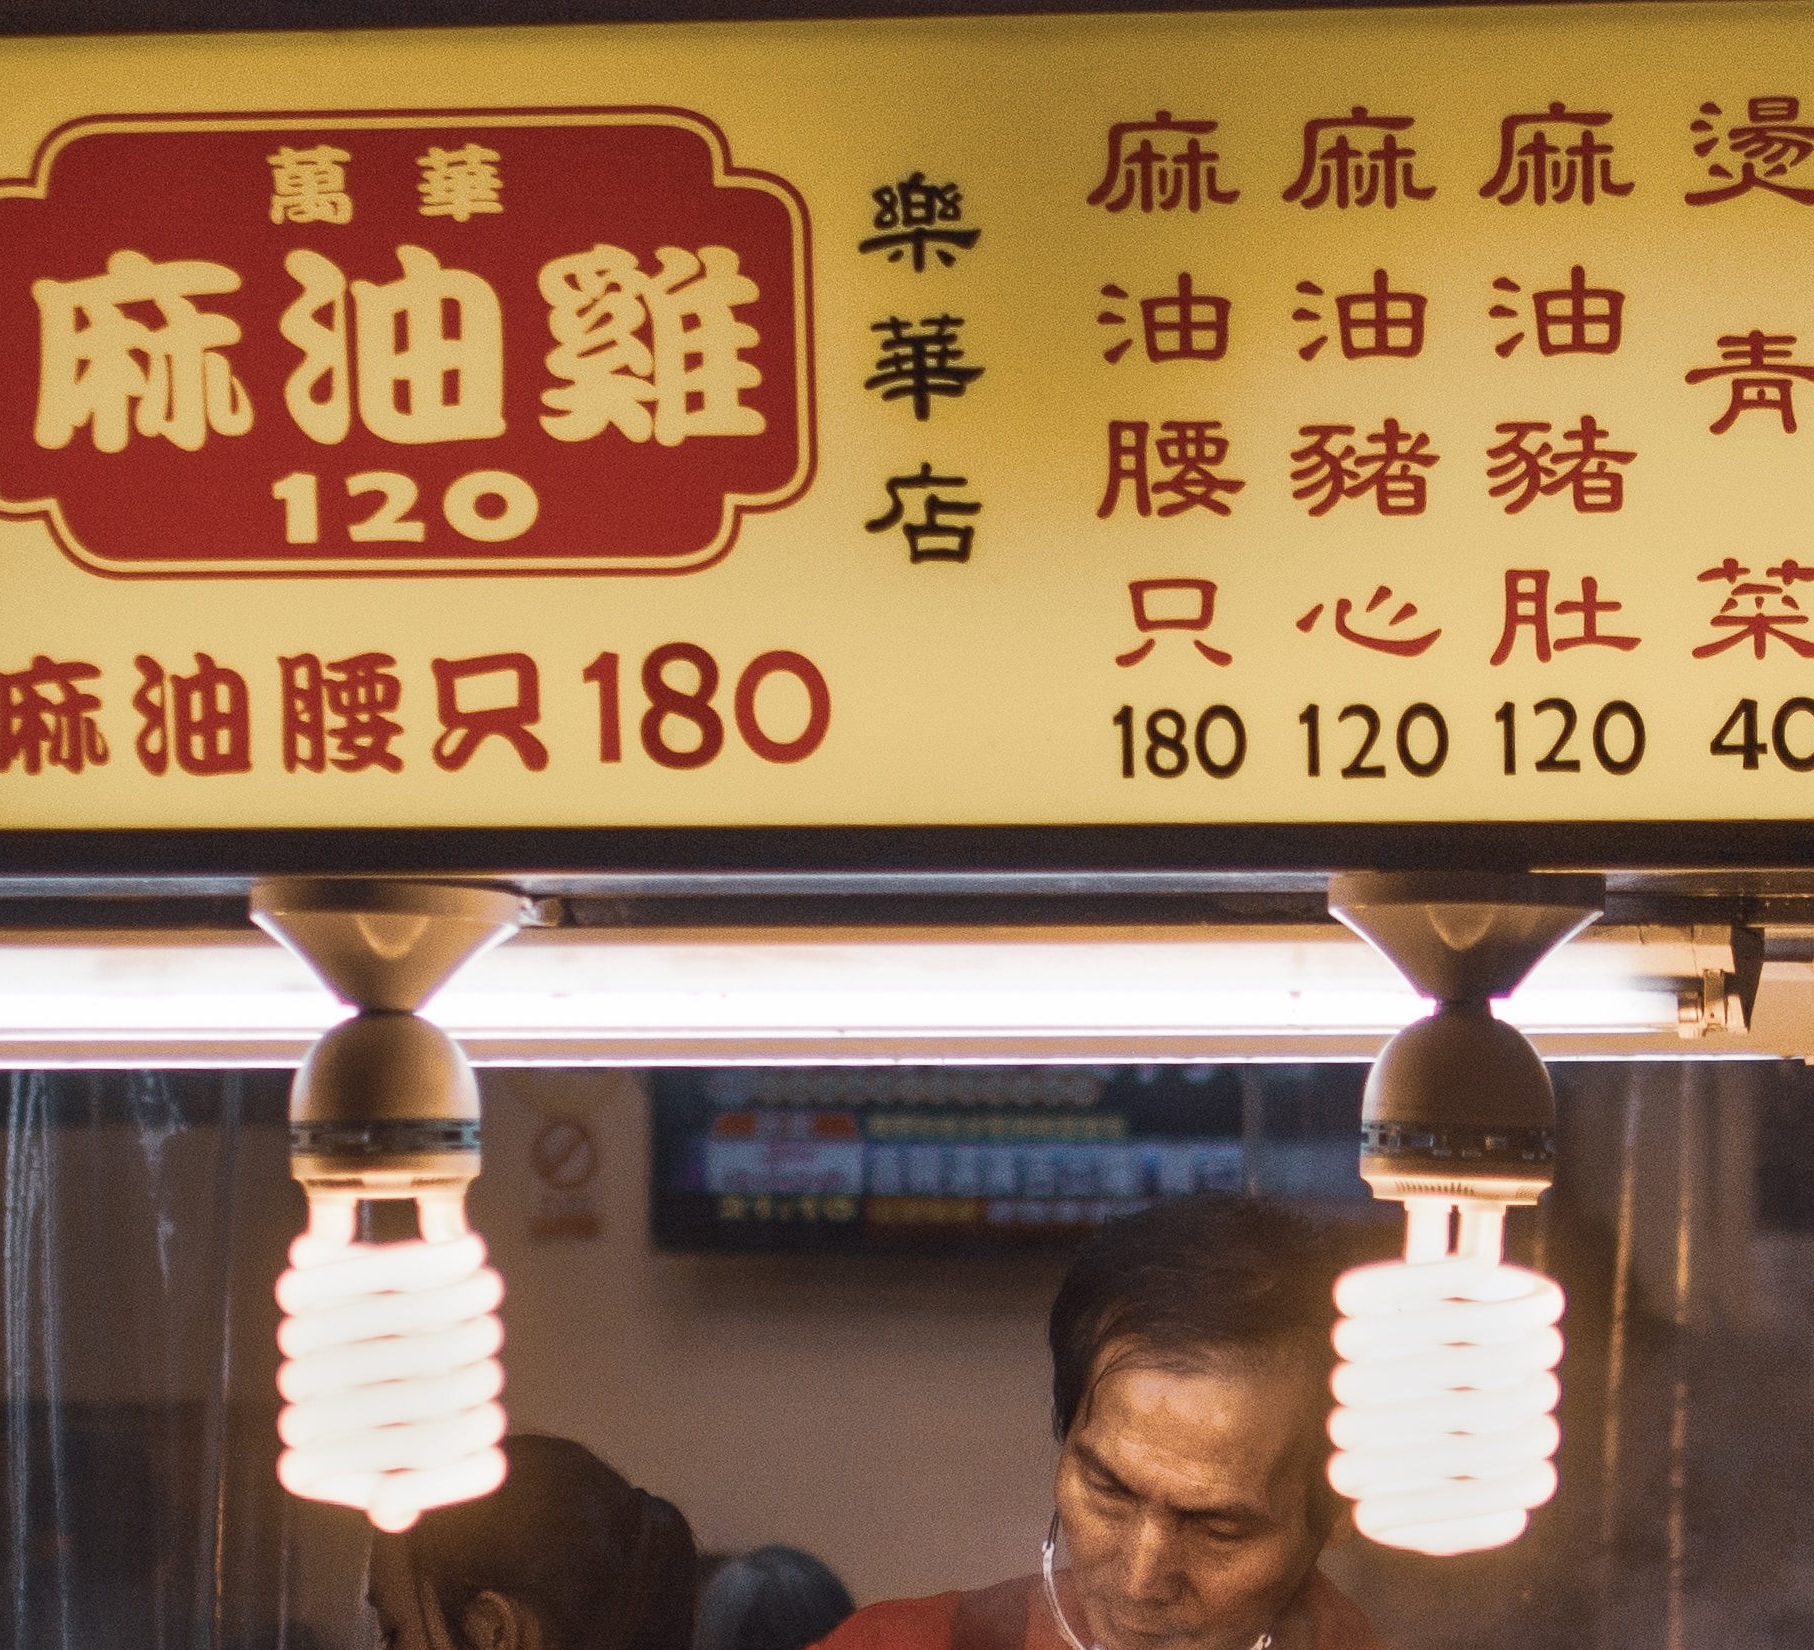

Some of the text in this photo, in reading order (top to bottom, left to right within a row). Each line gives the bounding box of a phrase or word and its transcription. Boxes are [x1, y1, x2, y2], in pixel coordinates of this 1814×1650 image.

[269, 144, 502, 223] 萬華
[33, 244, 765, 452] 麻油雞
[859, 173, 983, 564] 樂華店
[1088, 112, 1246, 778] 麻油腰只 180
[1283, 107, 1448, 778] 麻油豬心 120
[1480, 103, 1645, 775] 麻油豬肚 120
[273, 471, 538, 543] 120
[584, 642, 830, 769] 180
